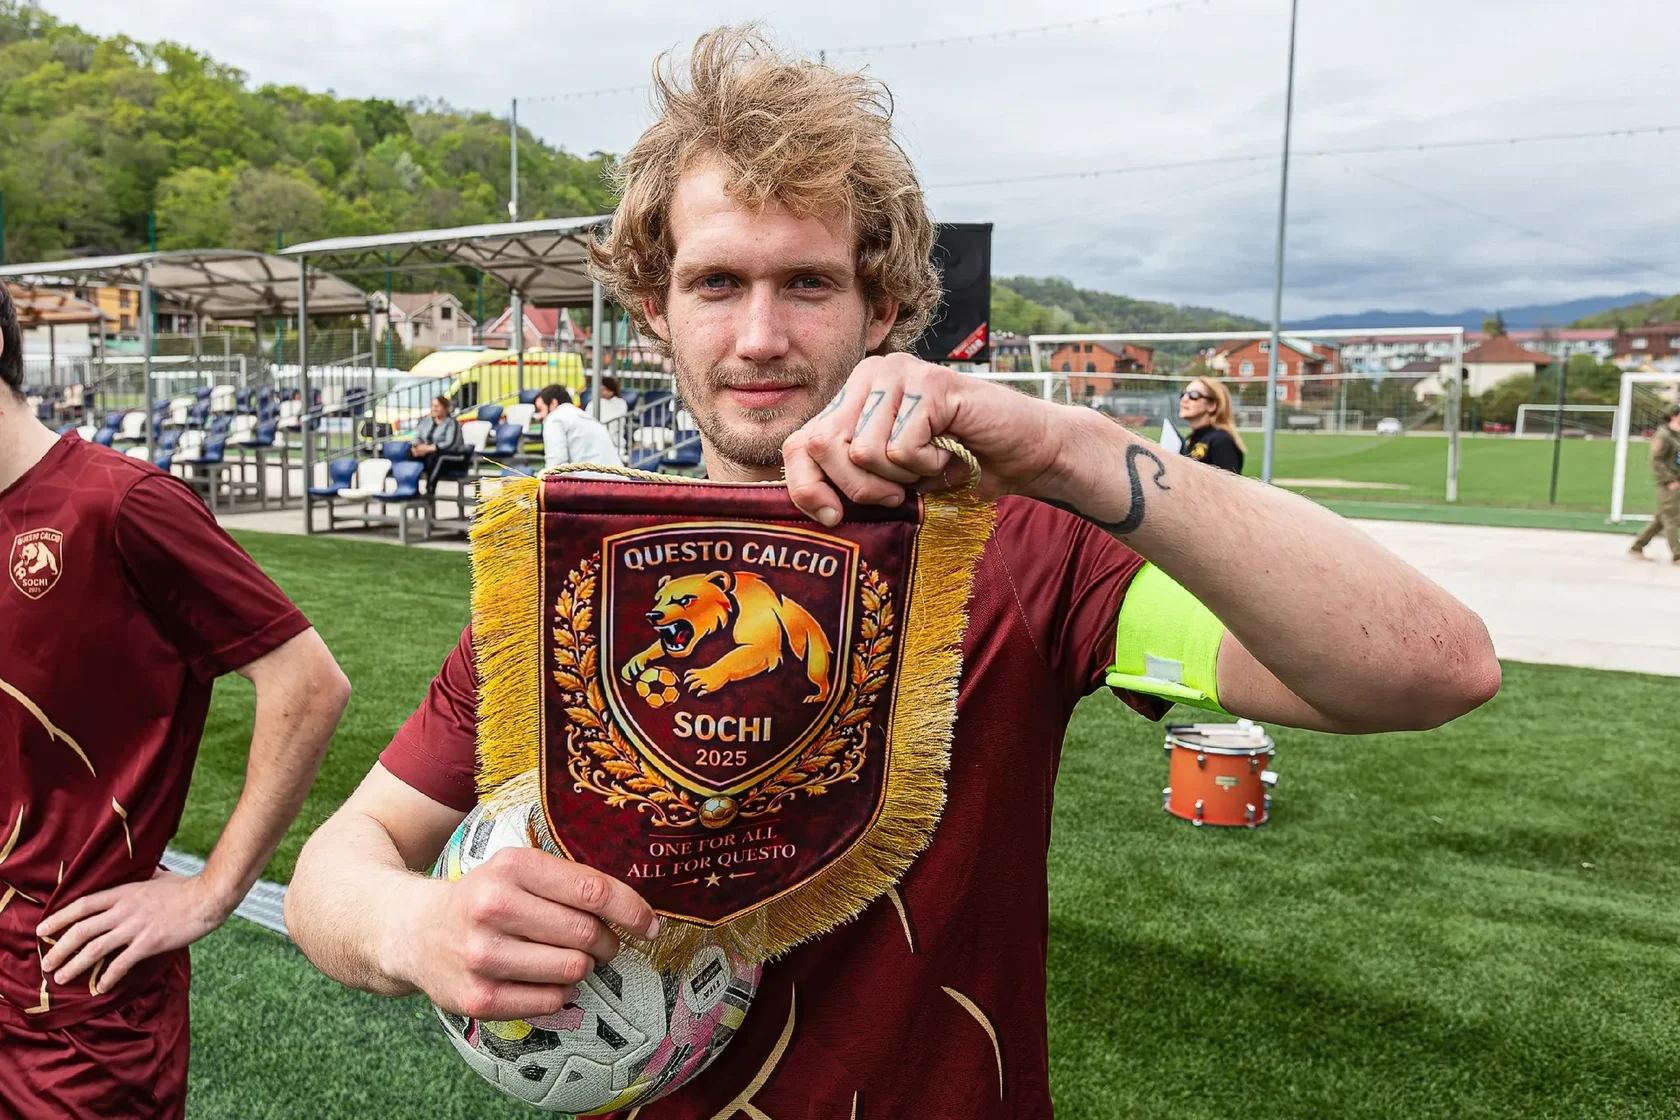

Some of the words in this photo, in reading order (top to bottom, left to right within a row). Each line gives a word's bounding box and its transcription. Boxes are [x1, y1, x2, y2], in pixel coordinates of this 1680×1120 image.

[624, 540, 733, 571] QUESTO
[742, 542, 838, 577] CALCIO
[22, 578, 48, 587] SOCHI
[672, 711, 772, 742] SOCHI
[695, 748, 747, 767] 2025
[649, 842, 692, 857] ONE
[699, 833, 736, 853] FOR
[742, 826, 778, 843] ALL
[626, 863, 666, 878] ALL
[672, 856, 711, 875] FOR
[717, 844, 797, 867] QUESTO
